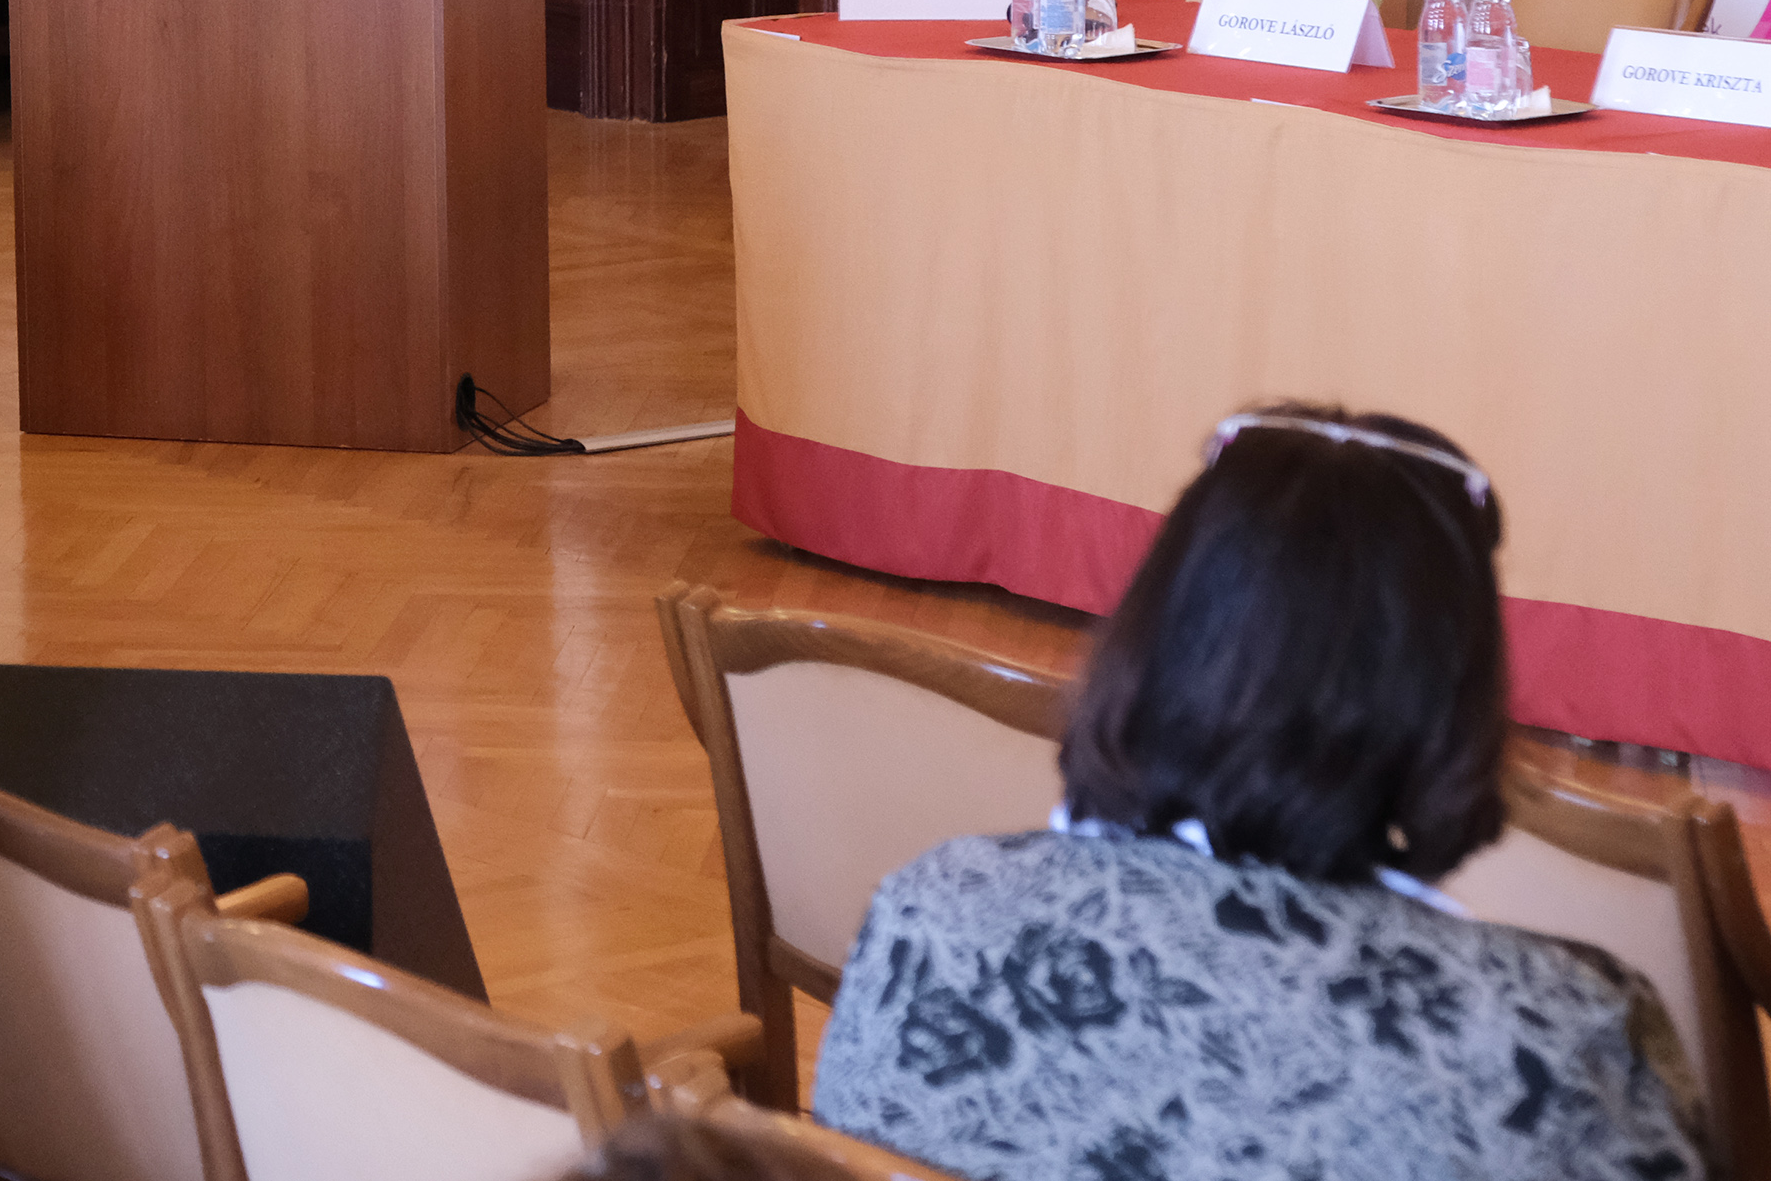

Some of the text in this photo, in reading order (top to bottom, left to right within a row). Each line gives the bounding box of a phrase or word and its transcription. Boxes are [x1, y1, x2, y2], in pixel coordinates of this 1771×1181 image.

[1218, 14, 1335, 40] GOROVE LÁSZLÓ
[1622, 65, 1763, 93] GOROVE KRISZTA
